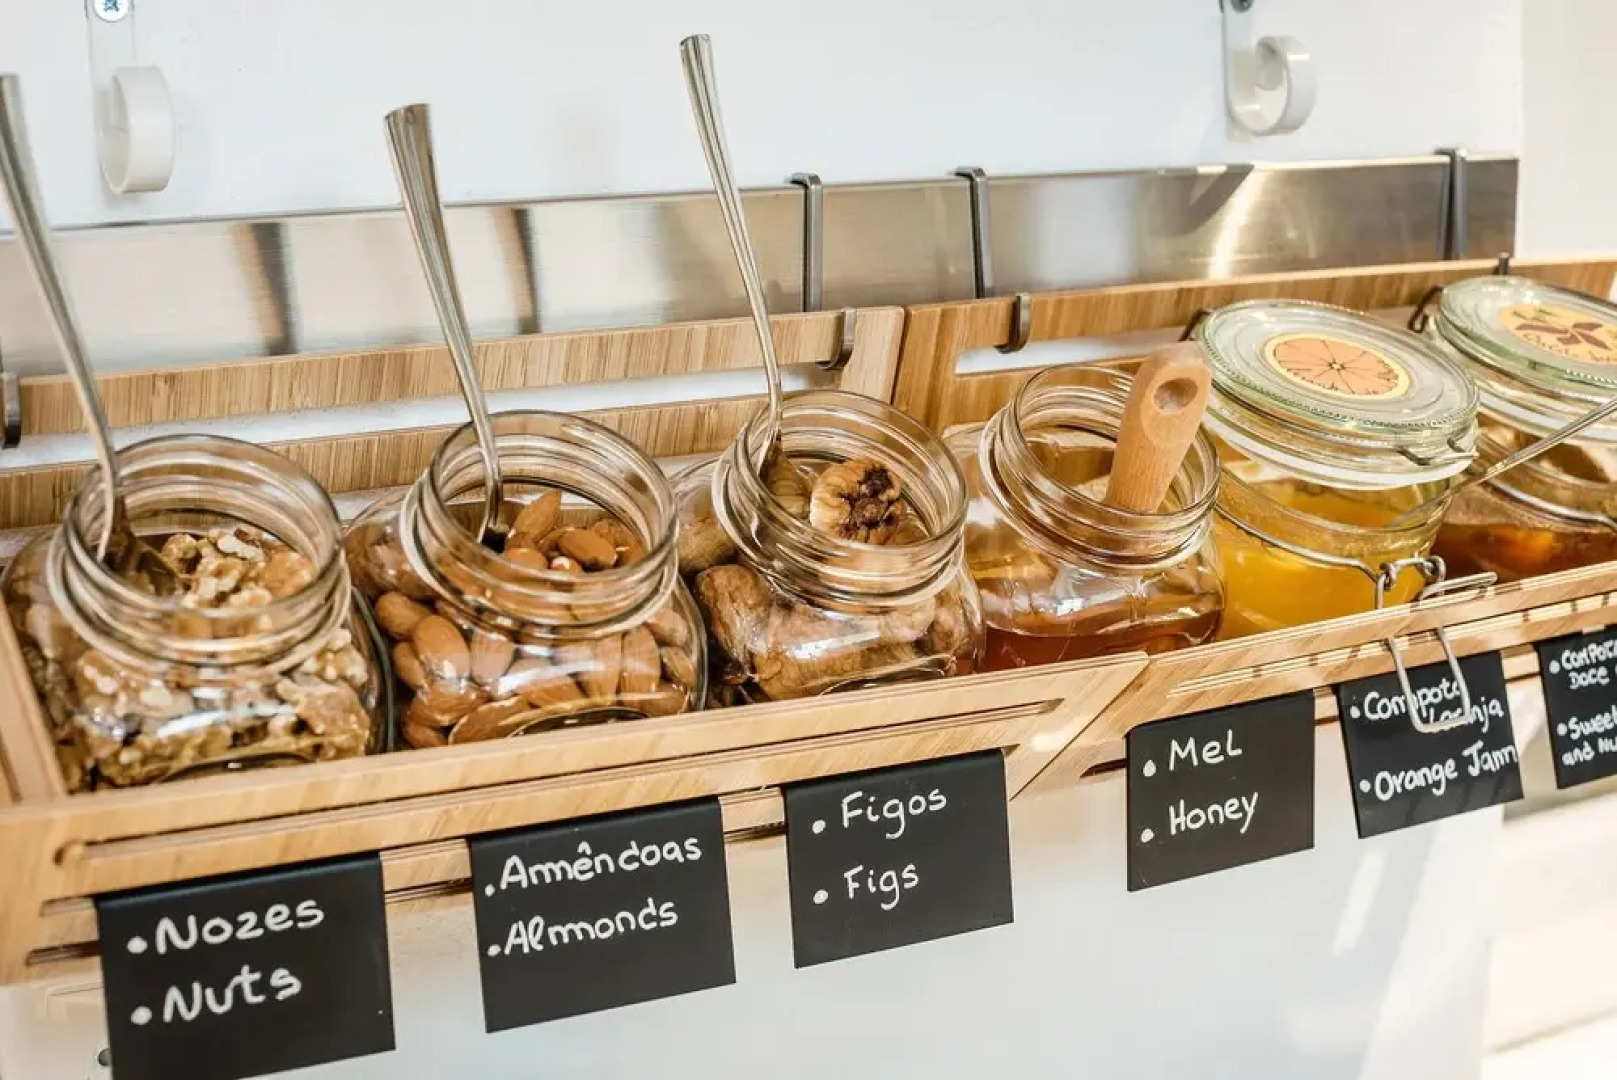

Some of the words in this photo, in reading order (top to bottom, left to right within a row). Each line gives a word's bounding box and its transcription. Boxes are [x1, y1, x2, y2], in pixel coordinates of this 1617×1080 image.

[1374, 757, 1458, 801] Orange
[1462, 739, 1518, 777] Jam
[841, 789, 947, 839] Figos
[1168, 792, 1258, 835] Honey
[500, 837, 702, 890] Amêndoas
[843, 863, 919, 910] Figs
[156, 900, 324, 955] Nozes
[504, 896, 678, 955] Almonds
[163, 964, 301, 1023] Nuts
